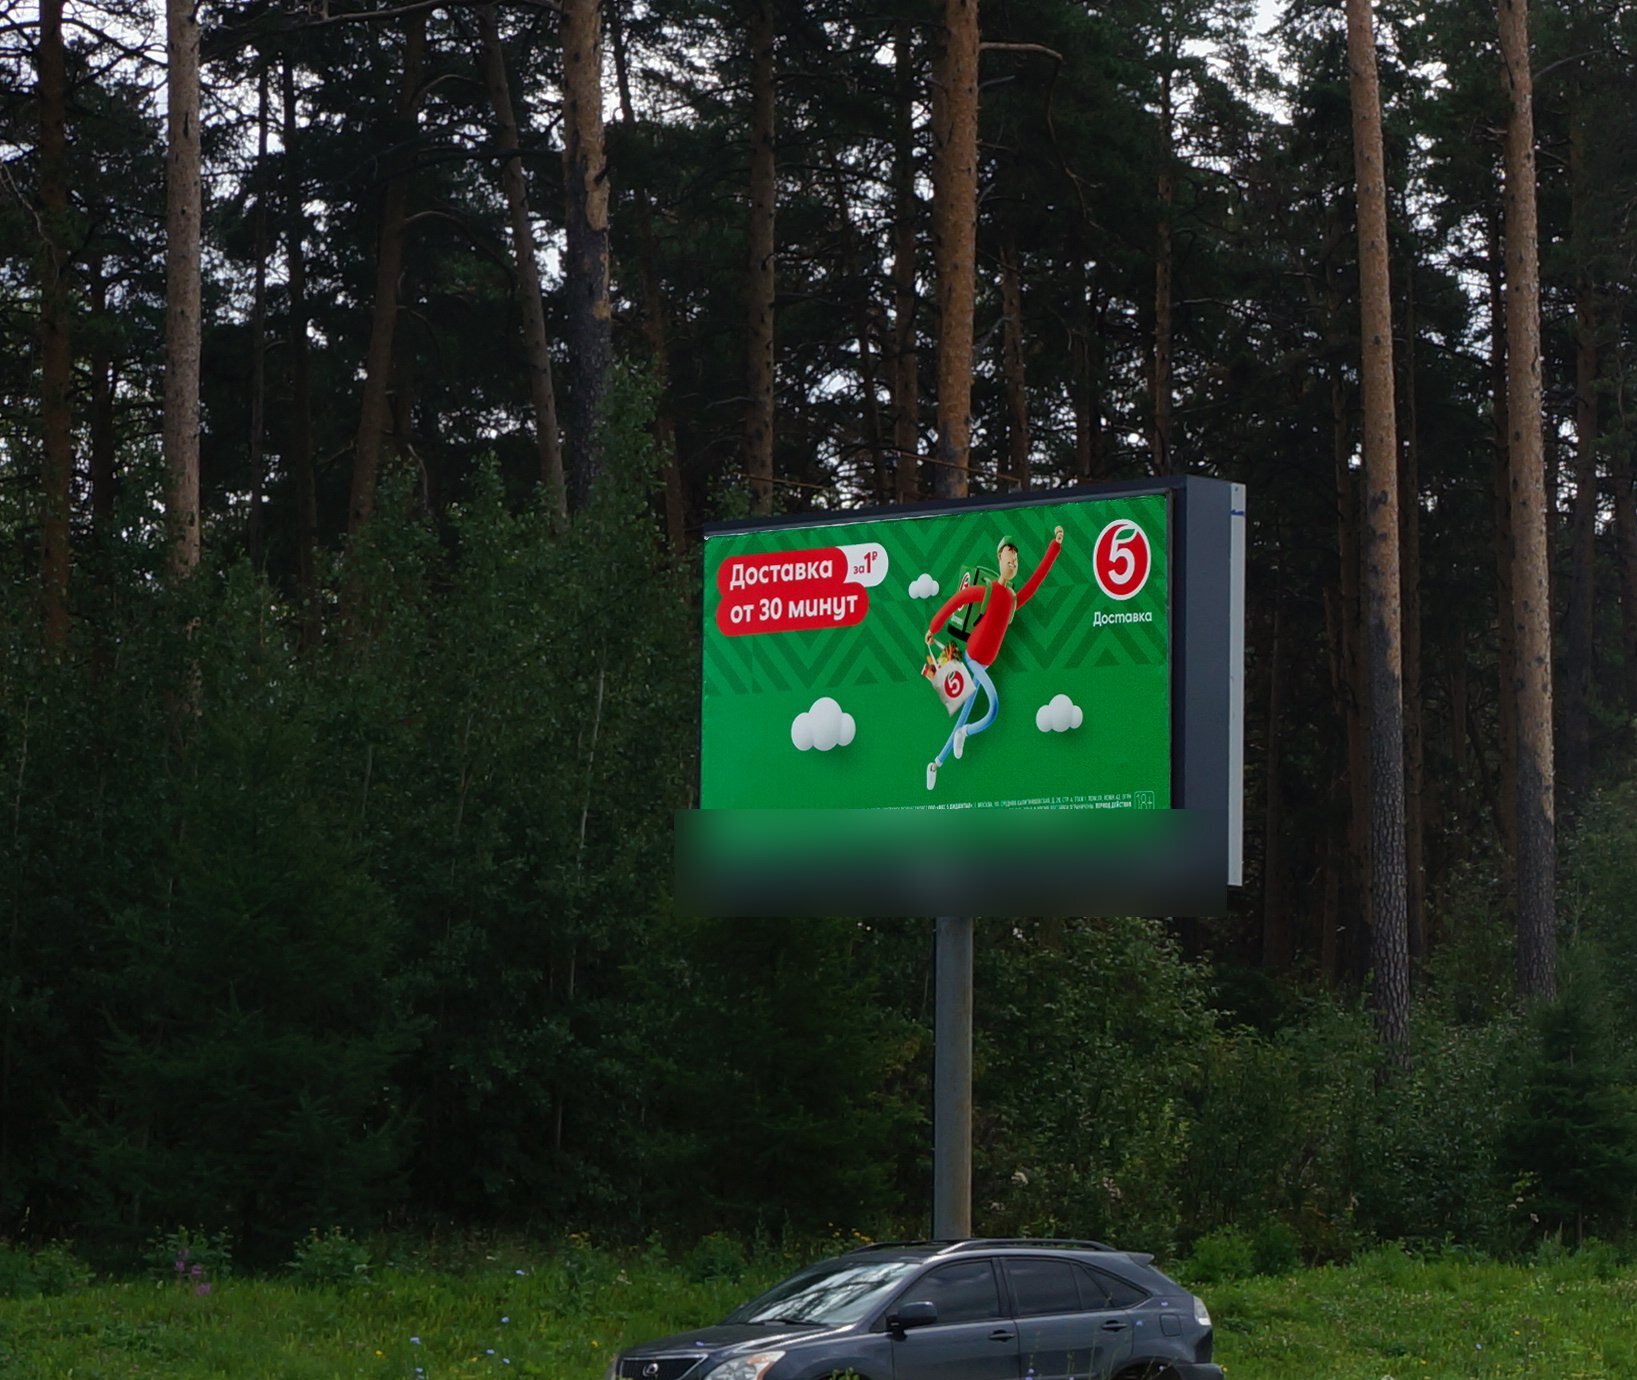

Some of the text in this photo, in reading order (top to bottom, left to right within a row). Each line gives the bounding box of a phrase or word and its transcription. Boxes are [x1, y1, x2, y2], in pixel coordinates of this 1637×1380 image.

[1108, 525, 1138, 585] 5
[730, 559, 833, 590] Доставка
[853, 566, 864, 575] за
[730, 595, 859, 624] от 30 минут
[1093, 611, 1152, 627] Доставка
